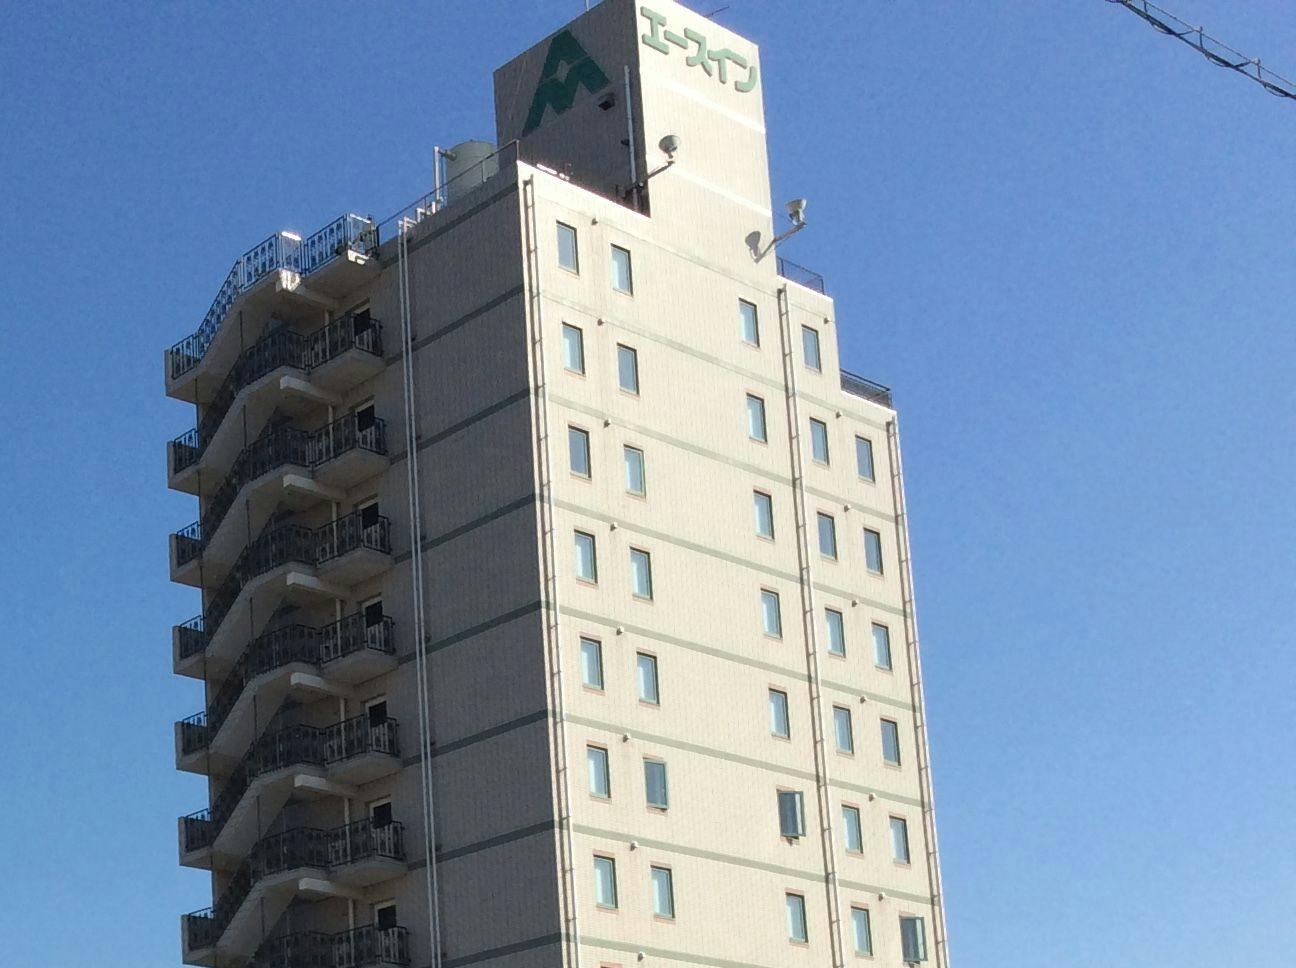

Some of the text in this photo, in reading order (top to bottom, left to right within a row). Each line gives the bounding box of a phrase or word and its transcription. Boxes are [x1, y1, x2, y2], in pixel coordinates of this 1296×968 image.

[640, 6, 758, 93] エースイン
